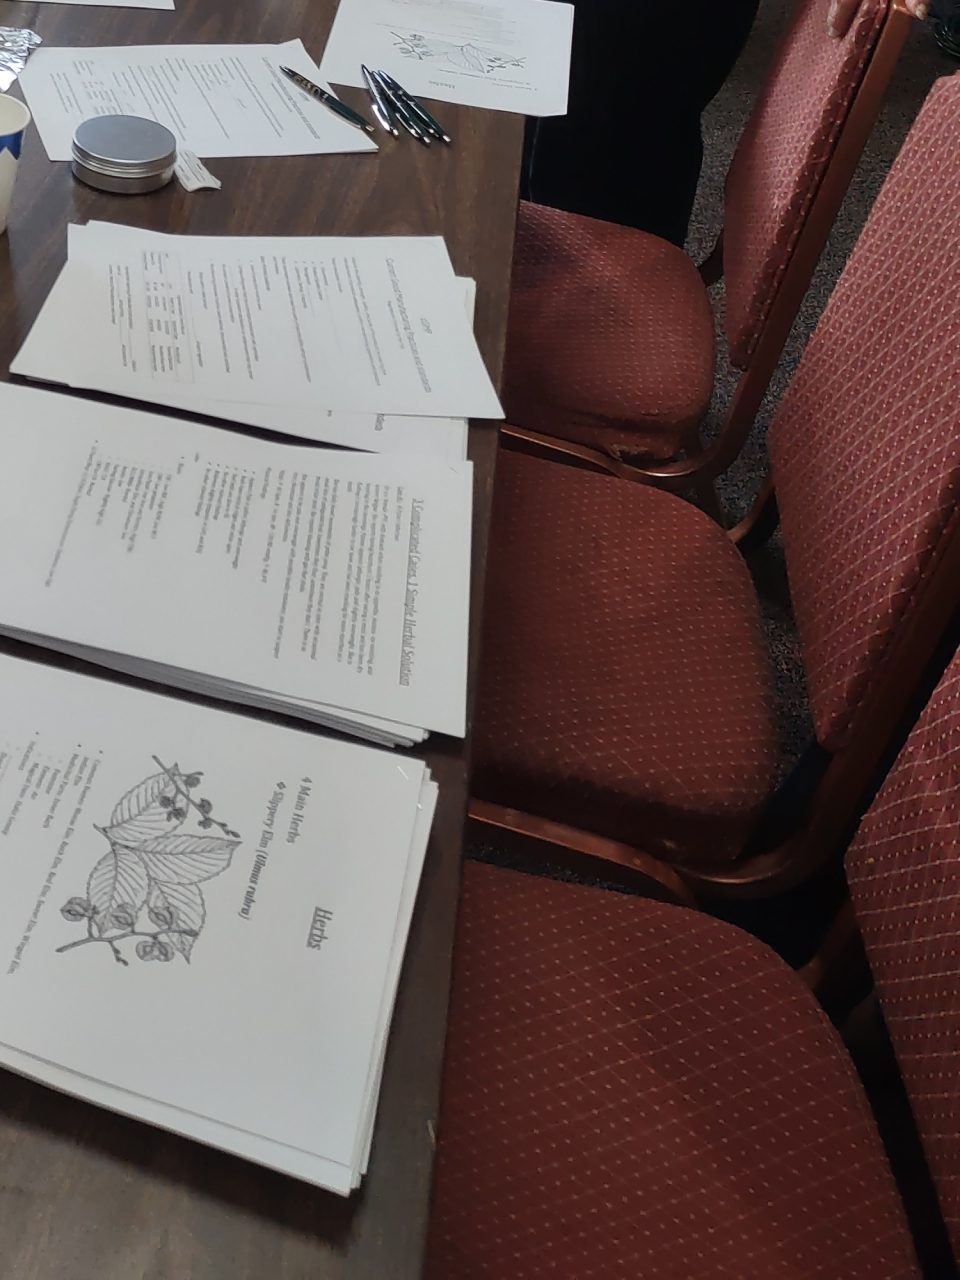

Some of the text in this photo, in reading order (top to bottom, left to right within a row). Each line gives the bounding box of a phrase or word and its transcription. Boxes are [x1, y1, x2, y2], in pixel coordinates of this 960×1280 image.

[403, 587, 417, 616] Simple
[401, 617, 415, 648] Herbal
[399, 648, 414, 685] Solution
[263, 791, 283, 828] Slippery
[295, 785, 310, 810] Main
[259, 829, 273, 848] Elm
[286, 813, 303, 843] Herbs
[307, 907, 332, 949] Herbs
